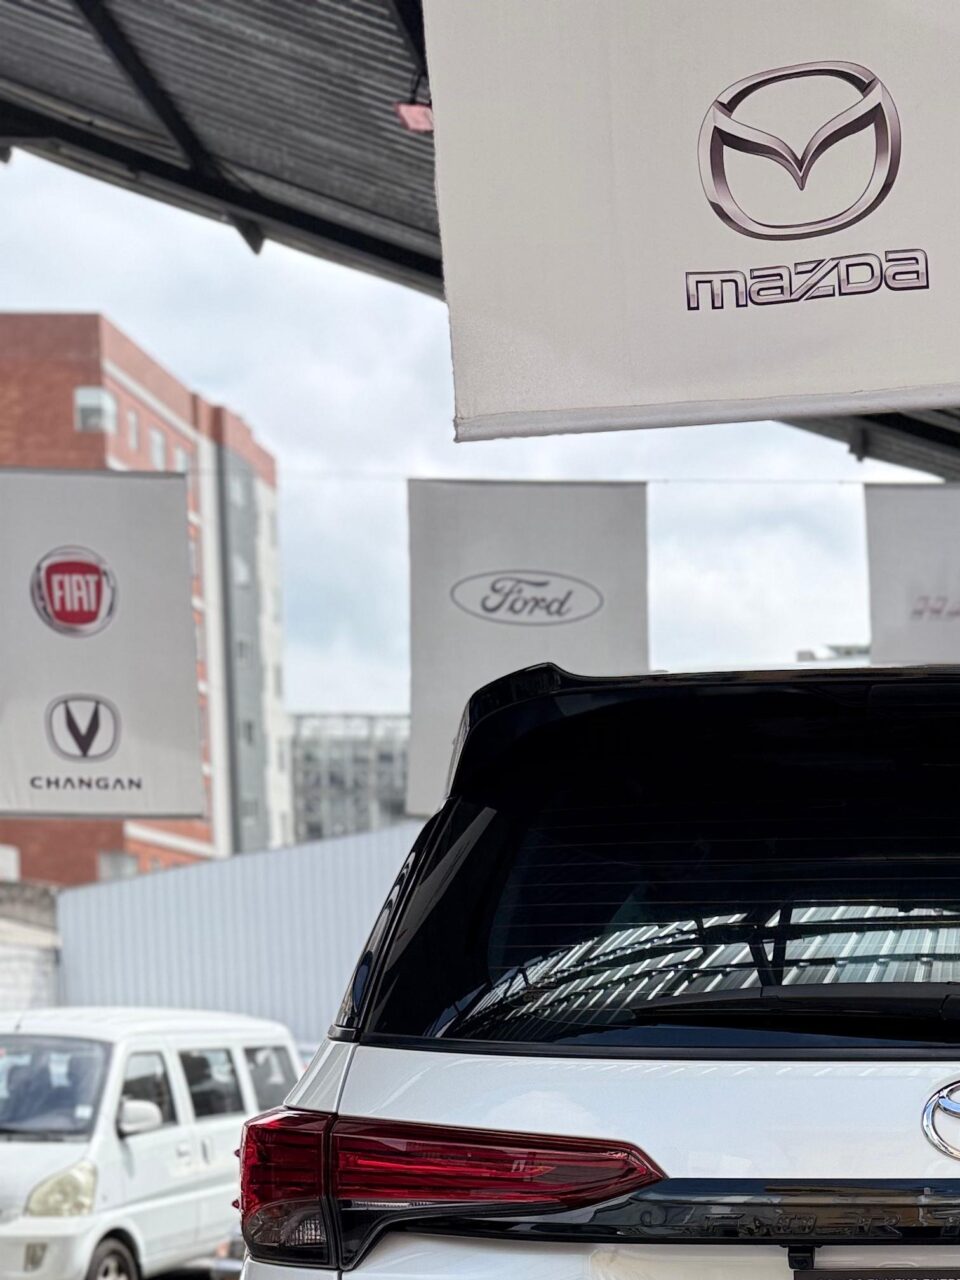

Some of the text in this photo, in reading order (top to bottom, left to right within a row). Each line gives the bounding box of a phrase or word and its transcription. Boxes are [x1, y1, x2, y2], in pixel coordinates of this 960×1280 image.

[51, 573, 99, 612] FIAT
[481, 576, 573, 617] Ford
[29, 776, 142, 791] CHANGAN
